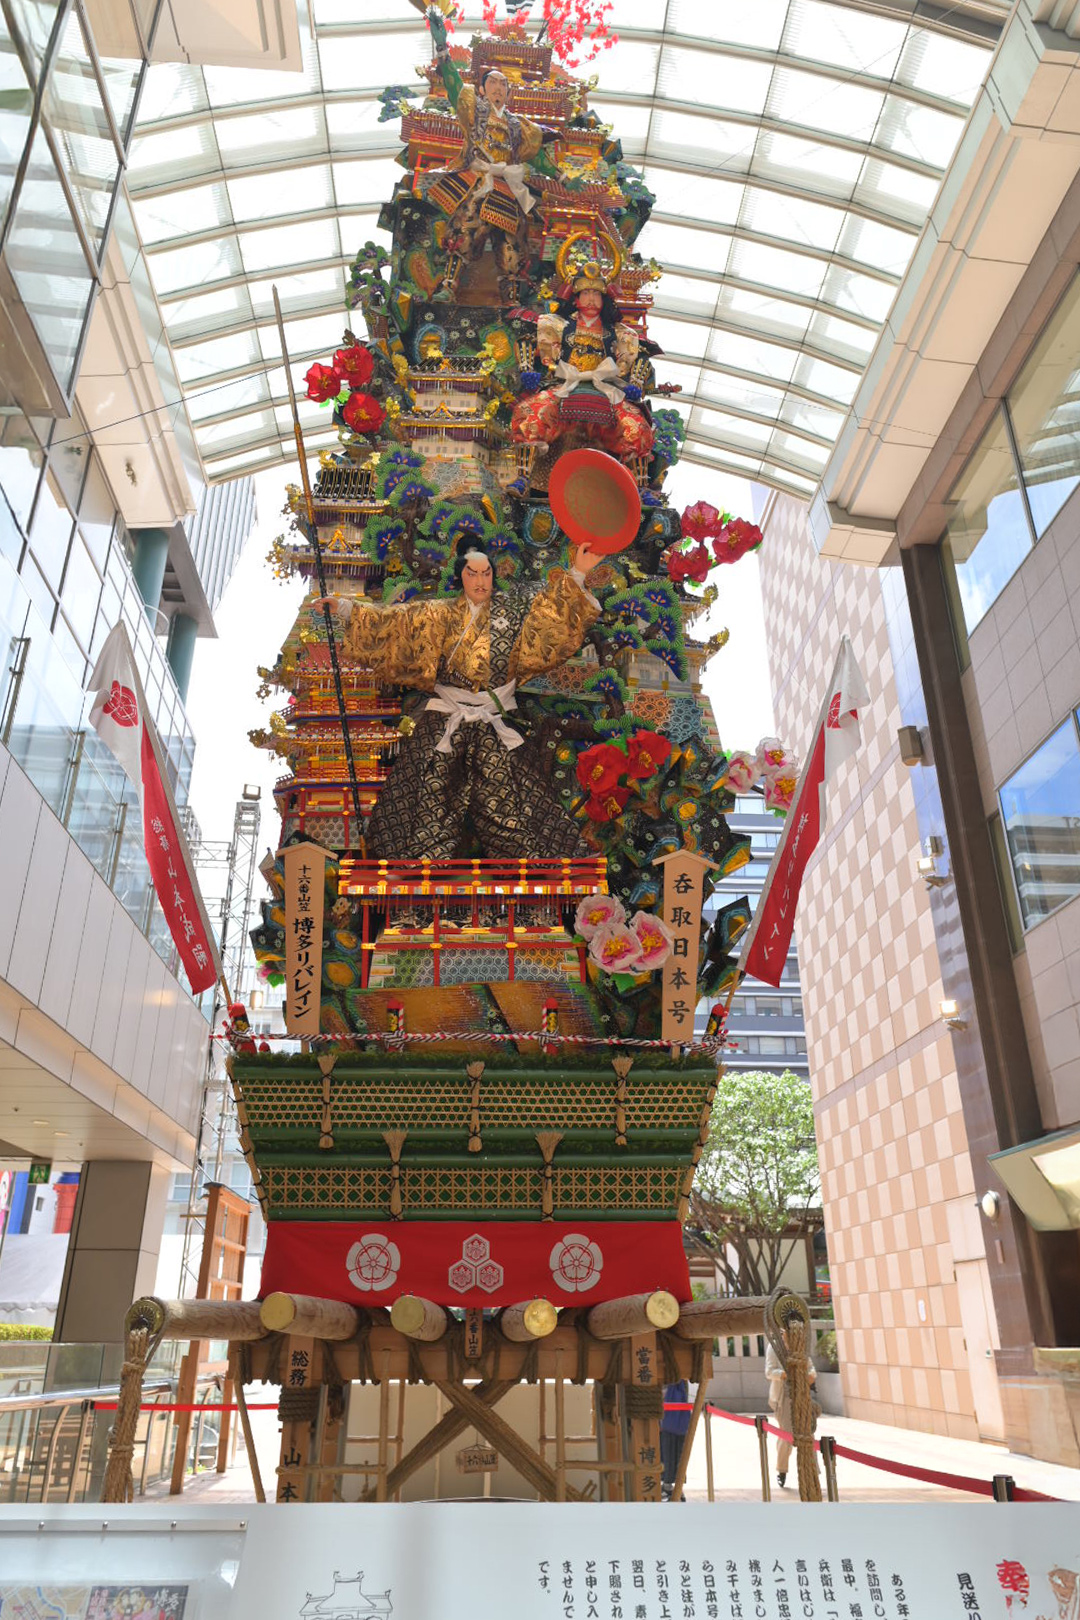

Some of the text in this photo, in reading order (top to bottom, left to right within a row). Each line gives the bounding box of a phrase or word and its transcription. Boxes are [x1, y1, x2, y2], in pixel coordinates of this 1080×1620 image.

[292, 864, 316, 1018] 十六番山笠 博多リバレイン
[667, 872, 695, 1024] 呑取日本号
[468, 1307, 480, 1357] 六番山笠
[289, 1349, 310, 1387] 総務
[635, 1346, 653, 1384] 當番
[279, 1446, 302, 1502] 山本
[537, 1560, 551, 1594] です。
[562, 1560, 575, 1619] ませんで
[586, 1560, 600, 1619] と申し入
[607, 1560, 624, 1619] 下賜され
[631, 1560, 648, 1620] 翌日、素
[655, 1560, 672, 1620] と引き上
[679, 1560, 696, 1620] みと注が
[702, 1560, 719, 1620] ら日本号
[726, 1560, 744, 1620] み千せば
[749, 1559, 767, 1620] 挑みまし
[772, 1559, 791, 1620] 人一倍忠
[795, 1559, 814, 1620] 言いはじ
[818, 1559, 840, 1620] 兵衛は「
[841, 1559, 864, 1620] 最中。福
[865, 1559, 888, 1620] を訪問し
[890, 1574, 910, 1620] ある年
